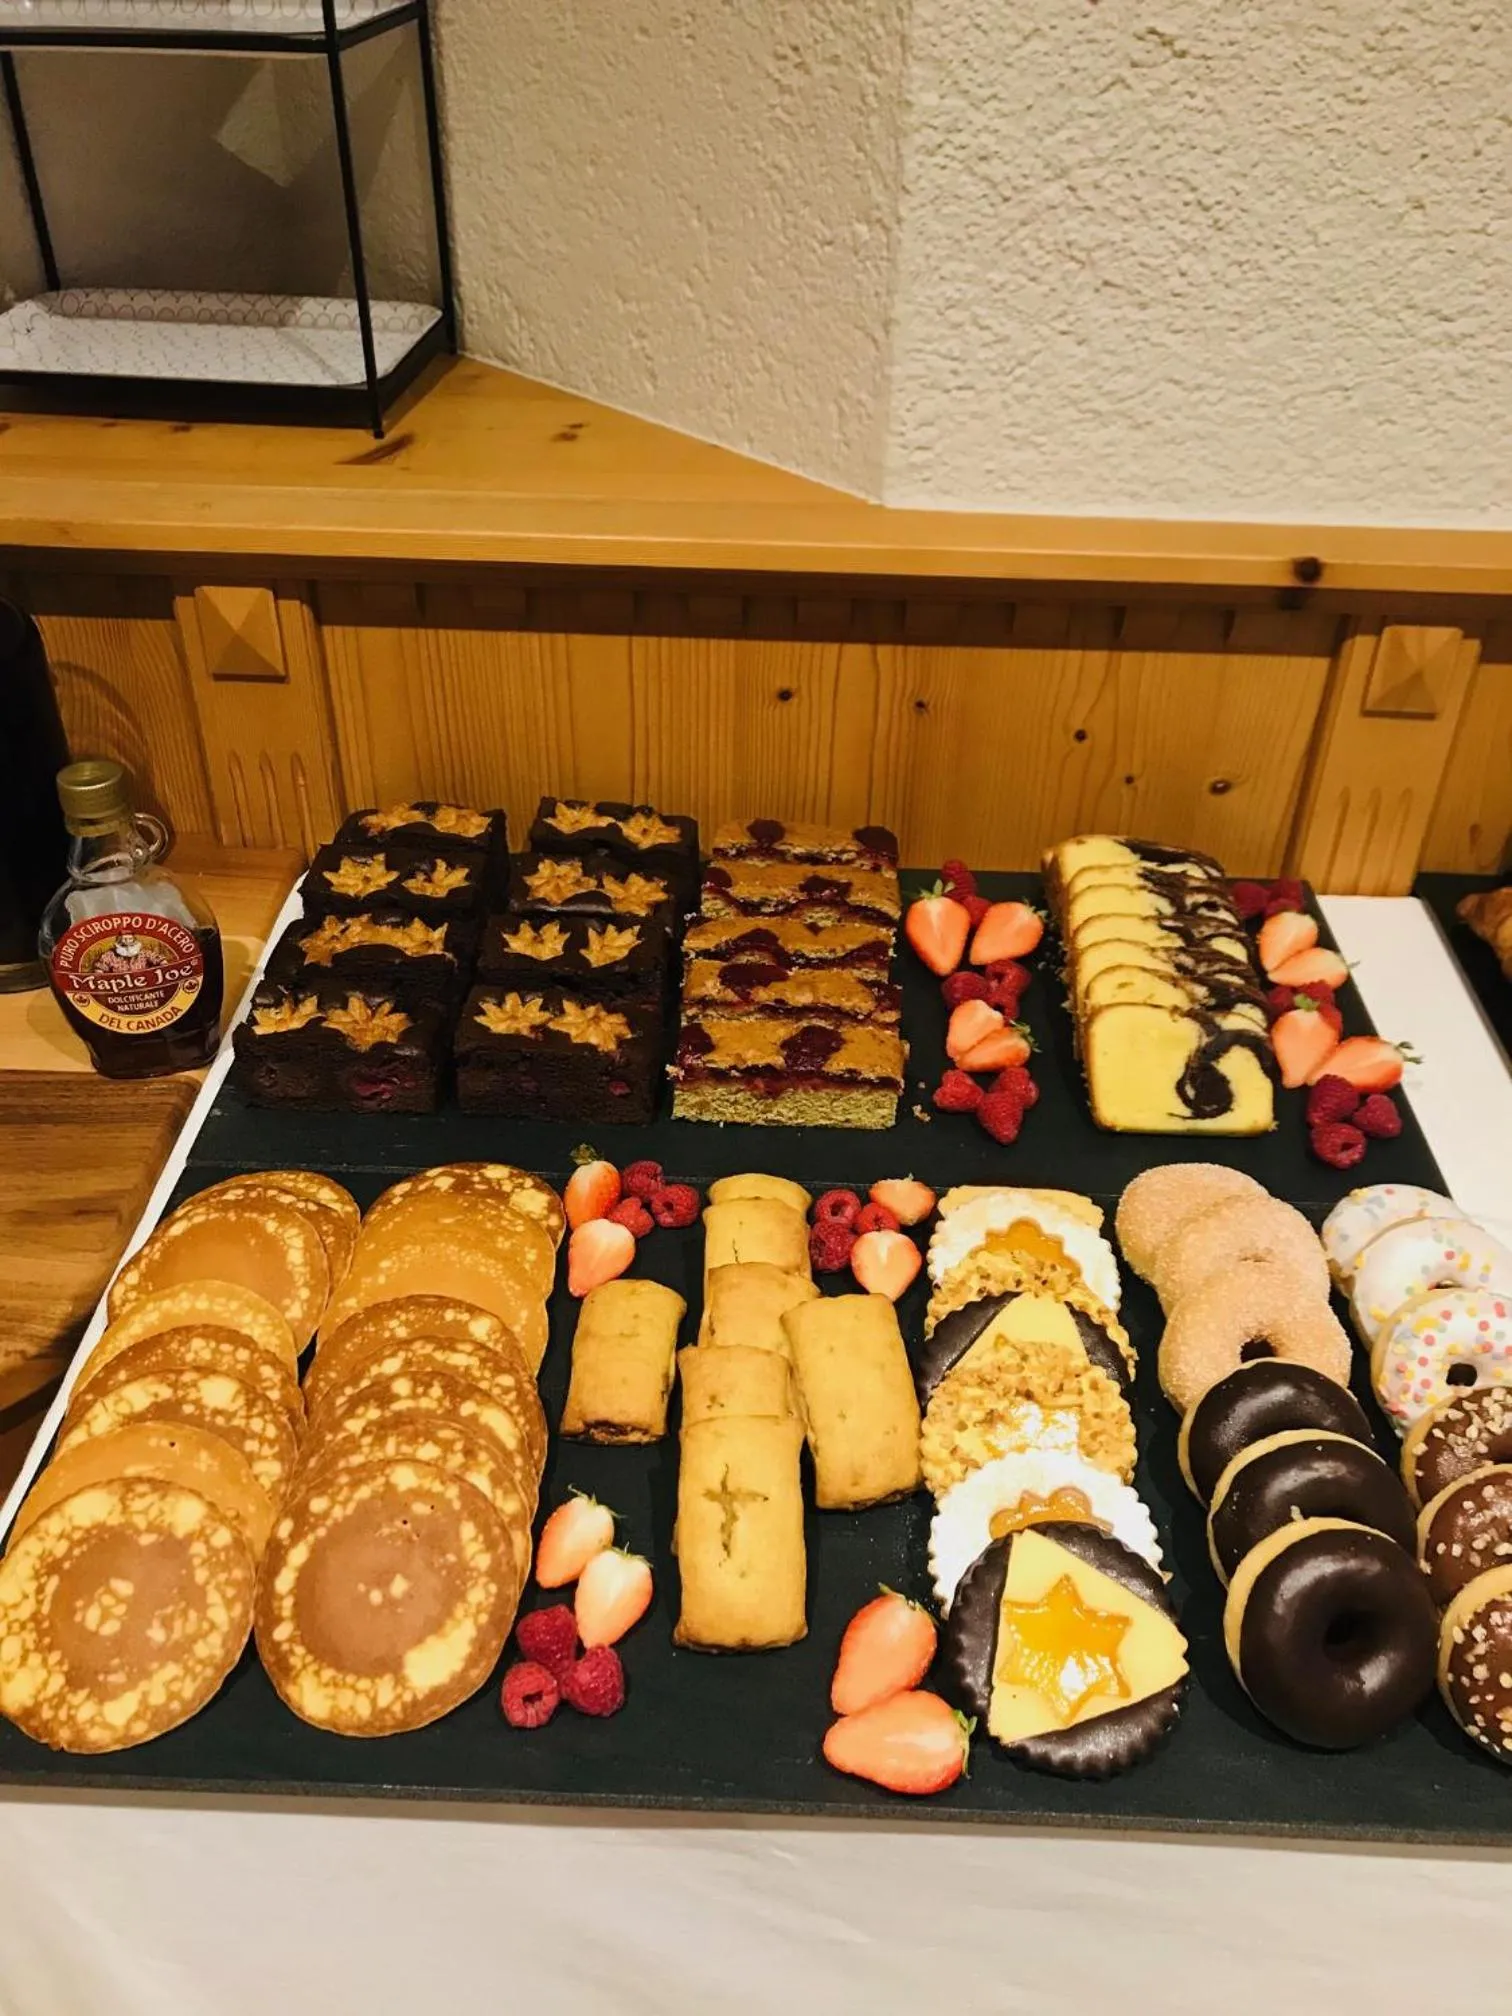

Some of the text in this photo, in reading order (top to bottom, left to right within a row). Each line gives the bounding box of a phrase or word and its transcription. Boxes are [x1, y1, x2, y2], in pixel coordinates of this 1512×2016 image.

[60, 916, 195, 968] PURO SCIROPPO D'ACERO
[69, 974, 147, 992] Maple
[107, 990, 165, 1004] DOLCIFICANTE
[117, 1000, 159, 1012] NATURALE
[99, 1005, 183, 1031] DEL CANADA
